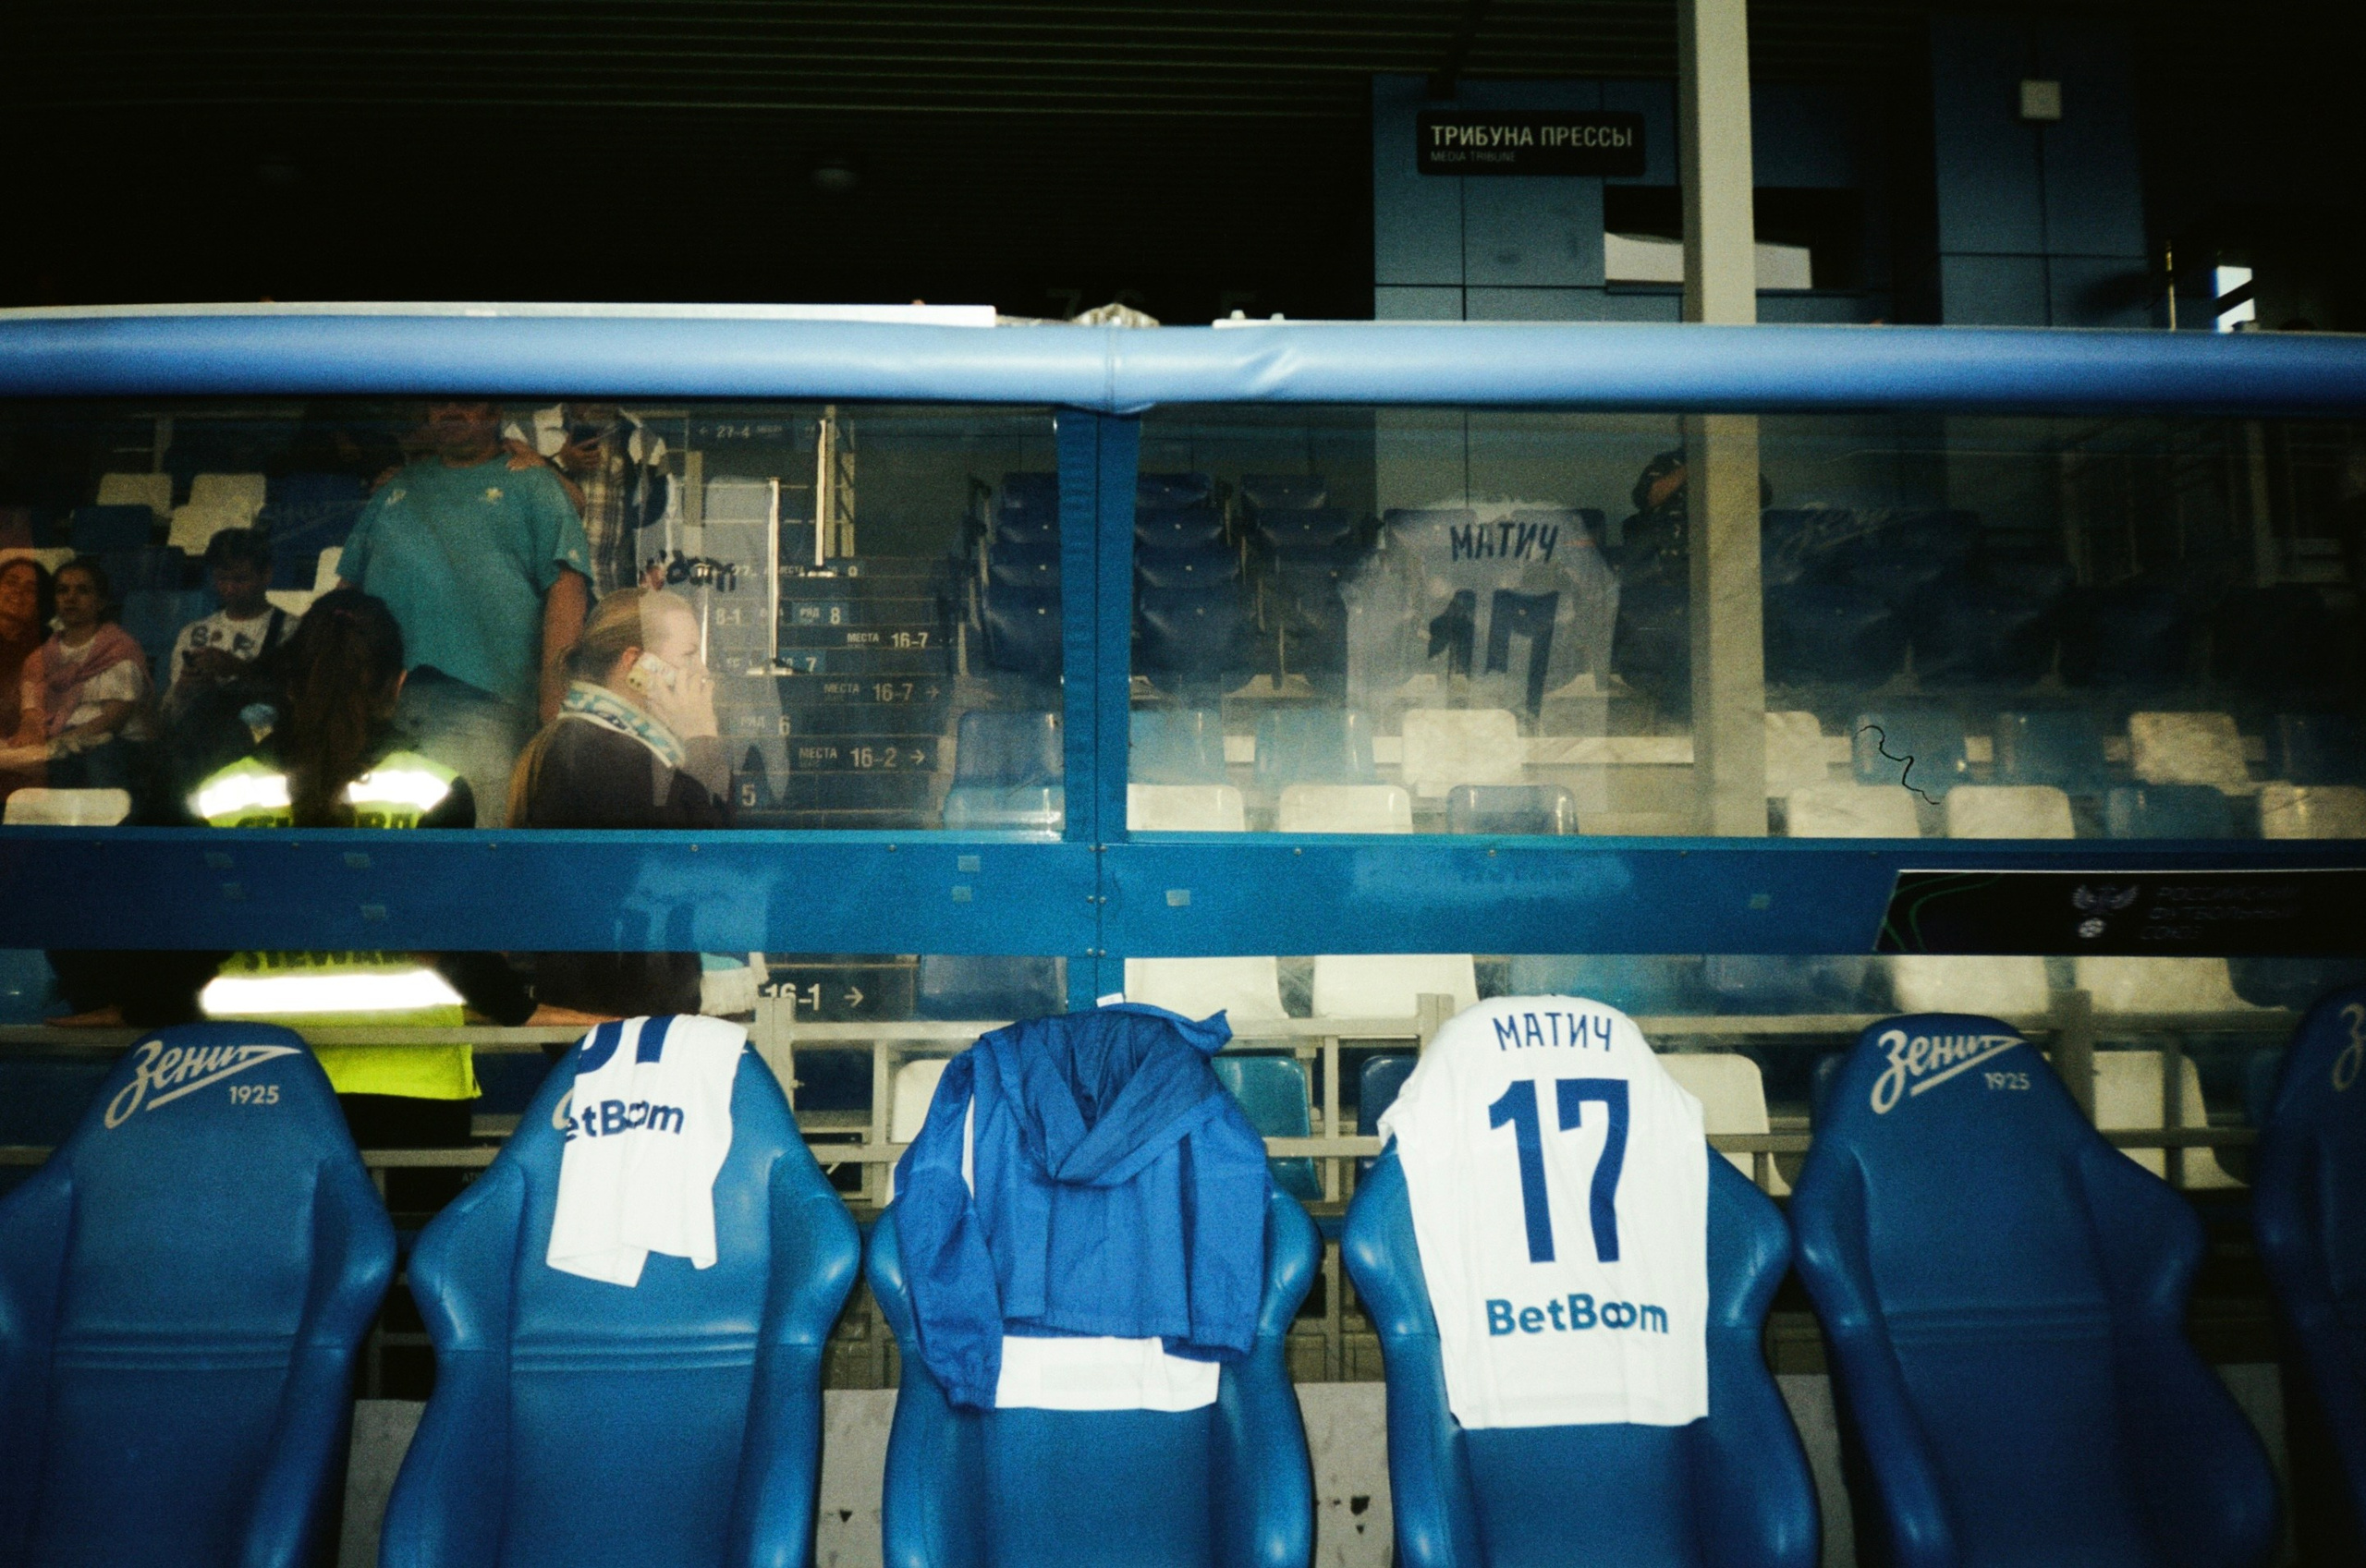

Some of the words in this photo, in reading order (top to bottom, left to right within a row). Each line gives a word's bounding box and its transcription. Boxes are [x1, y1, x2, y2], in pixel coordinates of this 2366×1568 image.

[1431, 126, 1534, 147] ТРИБУНА
[1541, 127, 1634, 147] ПРЕССЫ
[1432, 151, 1466, 162] MEDIA
[1470, 151, 1516, 163] TRIBUNE
[1449, 522, 1560, 562] МАТИЧ
[830, 606, 841, 625] 8
[847, 632, 879, 643] МЕСТА
[891, 631, 929, 648] 16-7
[805, 657, 817, 673] 7
[823, 683, 860, 694] МЕСТА
[872, 683, 914, 702] 16-7
[778, 715, 791, 736] 6
[799, 747, 837, 760] МЕСТА
[850, 747, 898, 769] 16-2
[741, 784, 757, 808] 5
[1493, 1012, 1612, 1051] МАТИЧ
[1870, 1029, 2031, 1115] Зенит
[1984, 1073, 2031, 1091] 1925
[104, 1039, 303, 1129] Зенит
[229, 1085, 280, 1105] 1925
[565, 1099, 685, 1143] etBoom
[1488, 1077, 1629, 1263] 17
[1485, 1294, 1669, 1336] BetBoom
